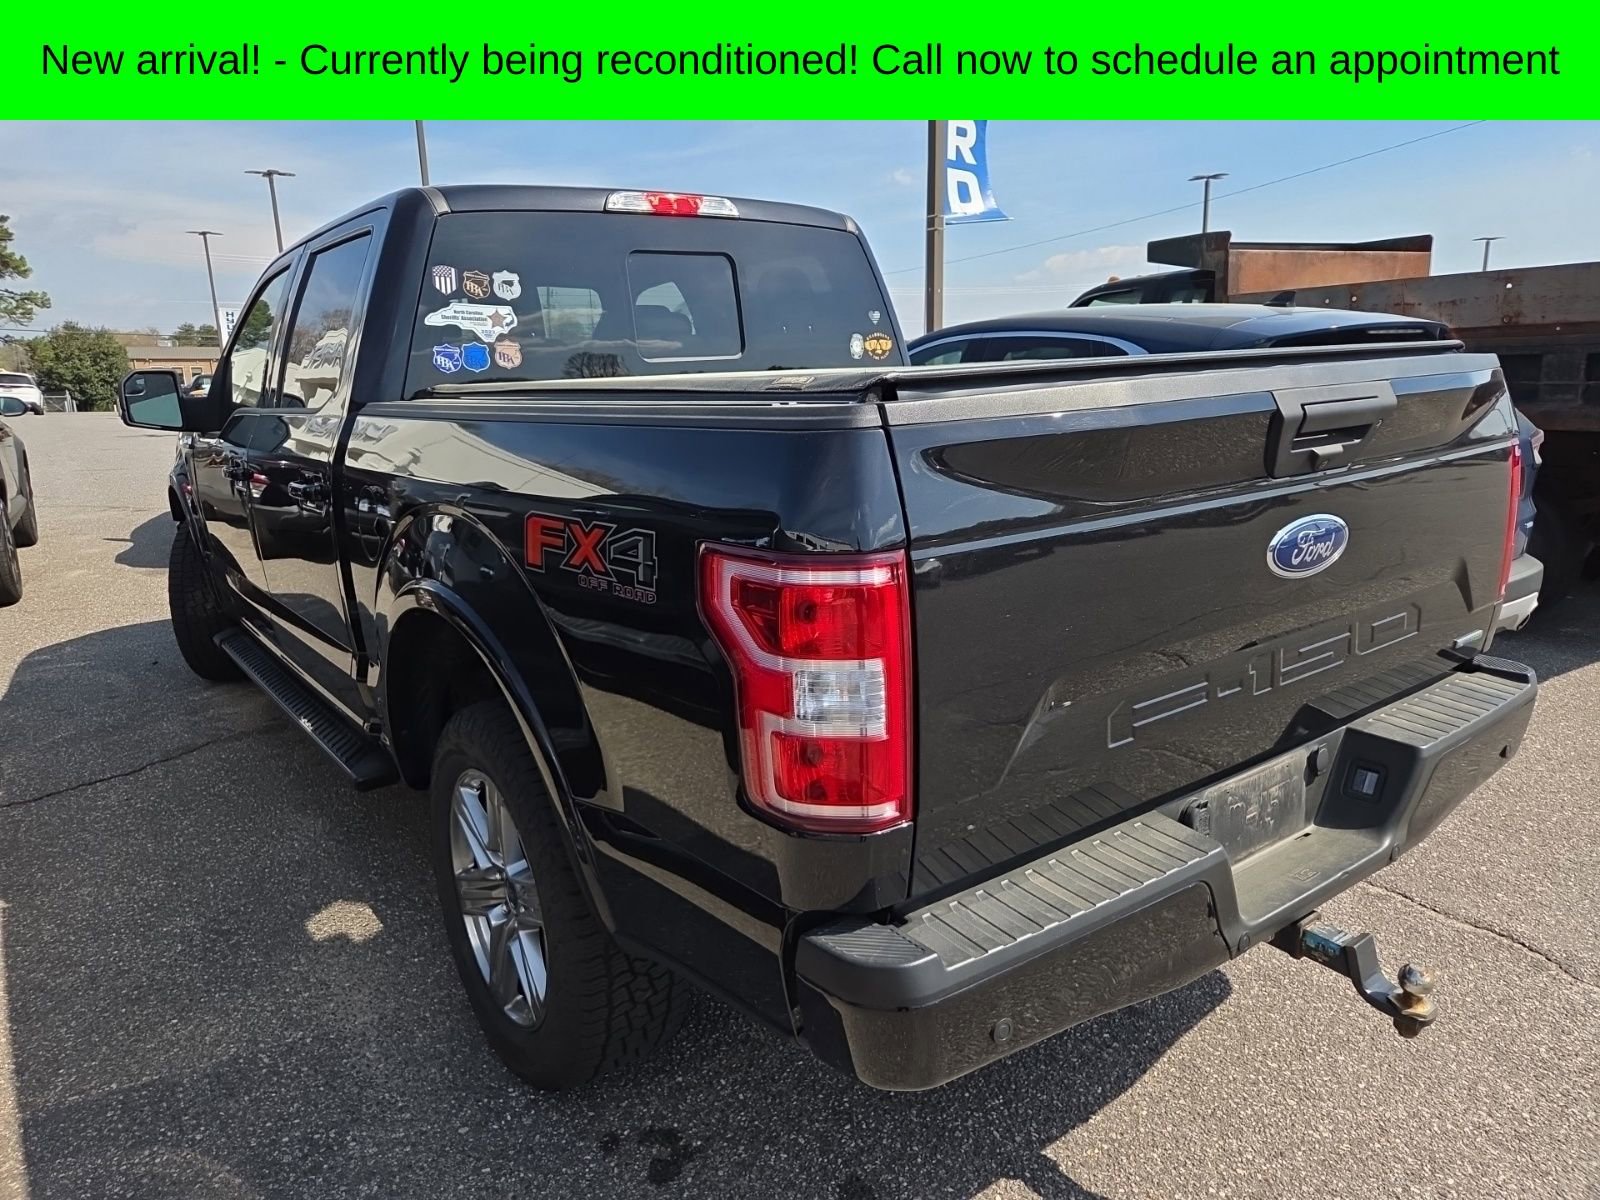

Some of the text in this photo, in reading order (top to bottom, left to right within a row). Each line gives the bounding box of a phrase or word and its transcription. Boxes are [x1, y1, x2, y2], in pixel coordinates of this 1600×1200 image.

[525, 511, 657, 591] FX4
[1291, 527, 1336, 566] Ford
[578, 574, 657, 604] OFF ROAD
[1107, 602, 1421, 749] F-150
